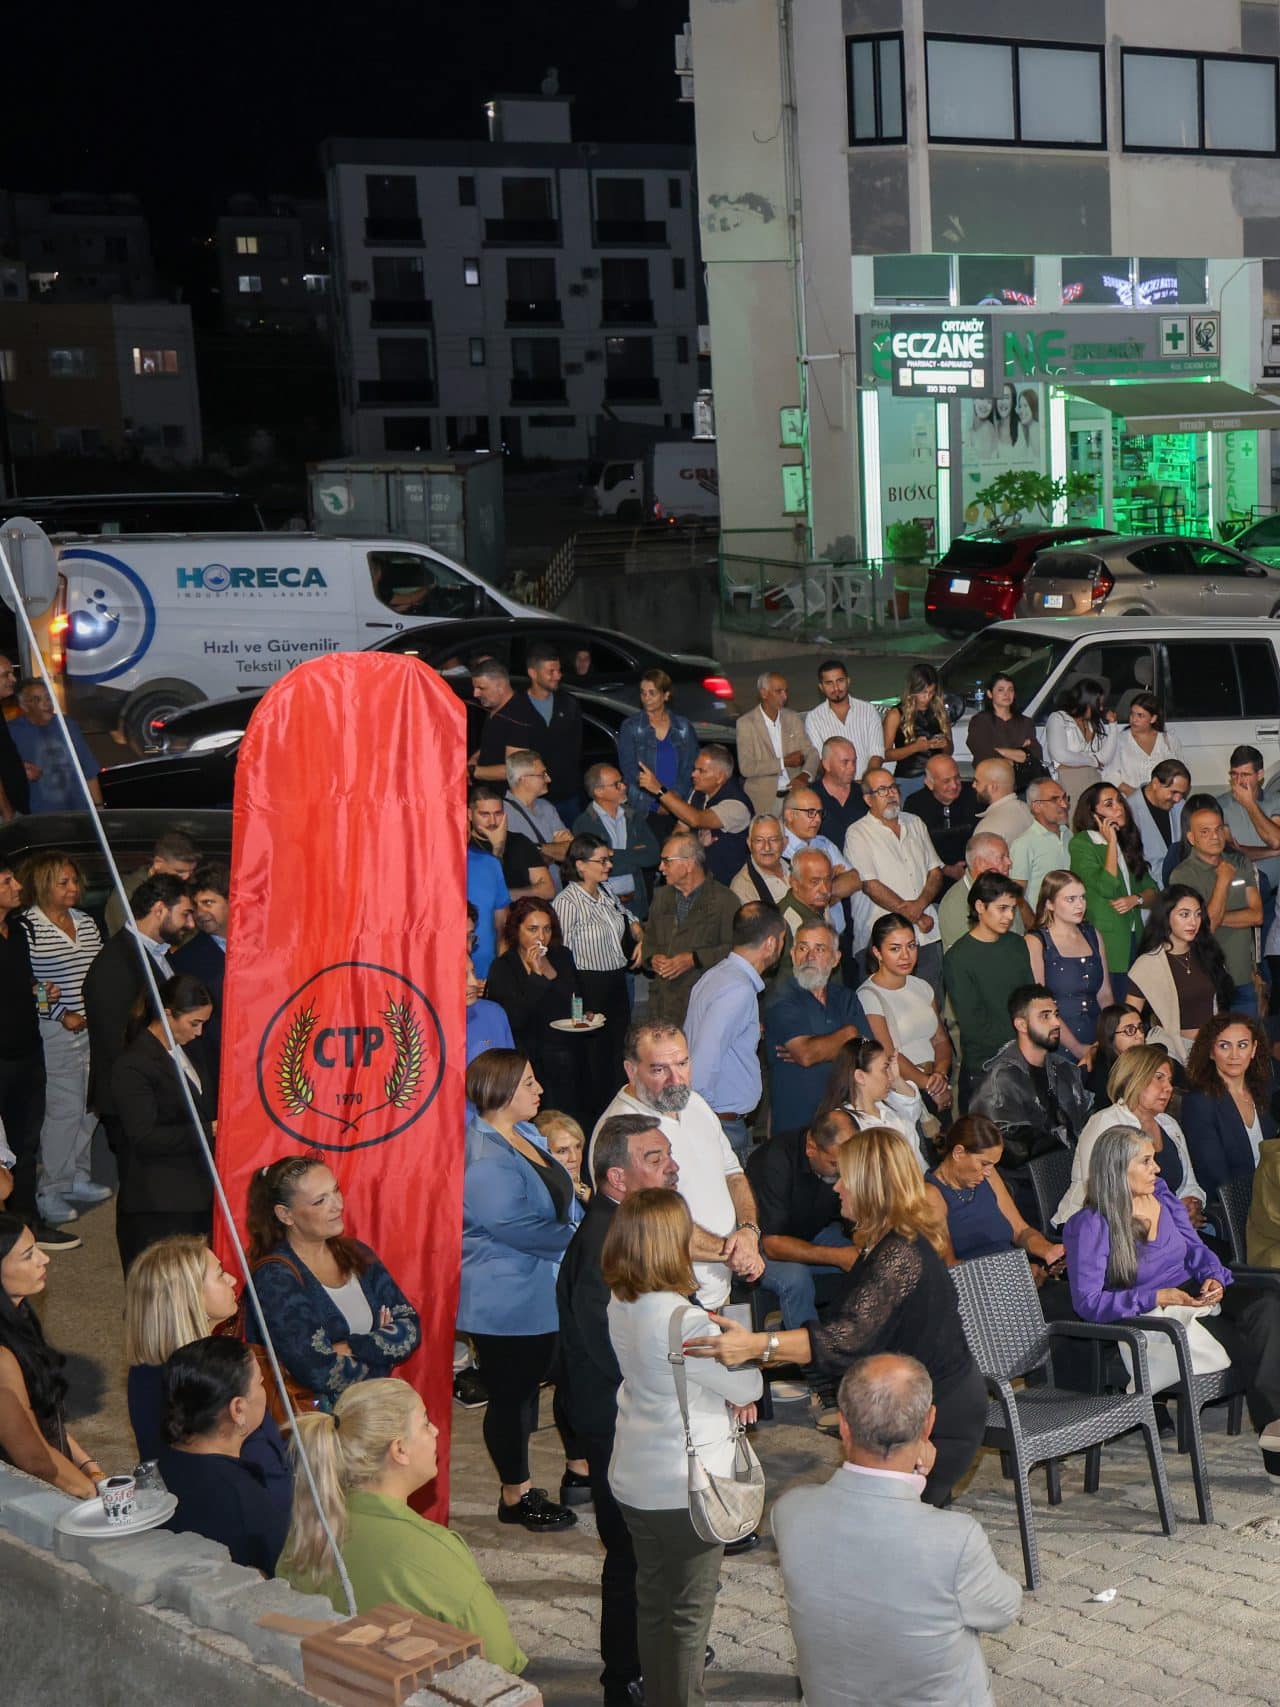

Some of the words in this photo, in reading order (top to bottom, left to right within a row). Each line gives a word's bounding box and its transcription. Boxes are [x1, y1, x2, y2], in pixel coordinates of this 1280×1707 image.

[942, 318, 984, 332] ORTAKÖY
[892, 333, 984, 358] ECZANE
[177, 564, 328, 592] HORECA
[177, 591, 263, 599] INDUSTRIAL
[204, 640, 239, 654] Hızlı
[244, 642, 262, 653] ve
[267, 638, 341, 653] Güvenilir
[236, 659, 281, 673] Tekstil
[313, 1026, 385, 1068] CTP
[336, 1093, 362, 1105] 1970
